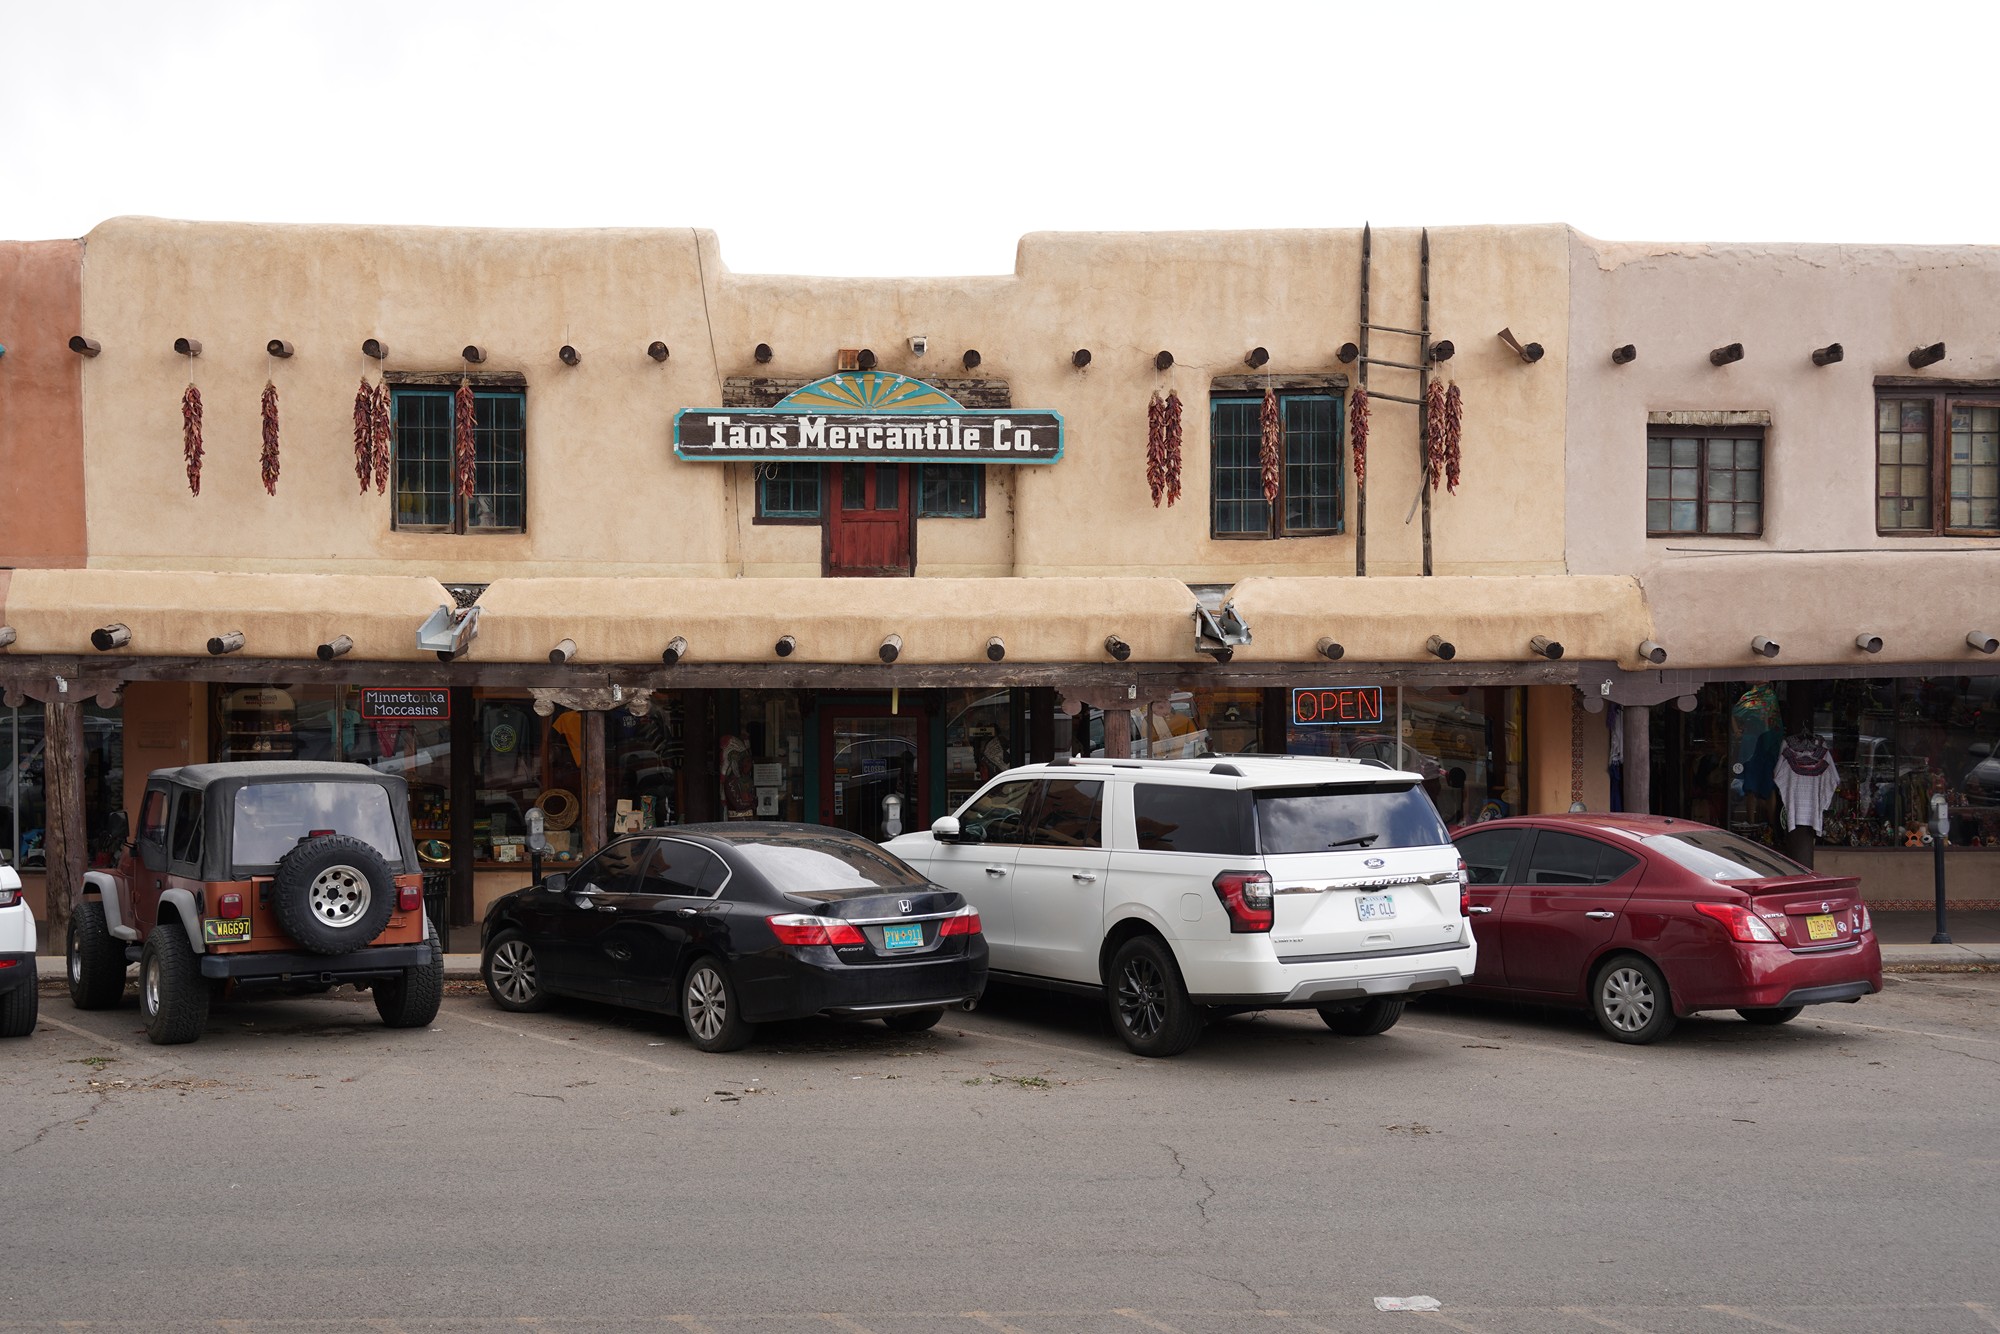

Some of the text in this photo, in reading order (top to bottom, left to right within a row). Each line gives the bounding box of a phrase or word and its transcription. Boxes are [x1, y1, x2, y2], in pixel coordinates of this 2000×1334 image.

[707, 416, 1040, 451] Taos Mercantile Co.
[366, 691, 446, 703] Minnetonka
[374, 704, 439, 716] Moccasins
[1297, 689, 1378, 721] OPEN
[1335, 876, 1419, 888] EXPEDITION
[1360, 902, 1395, 917] 545 CLL
[907, 928, 922, 941] 911
